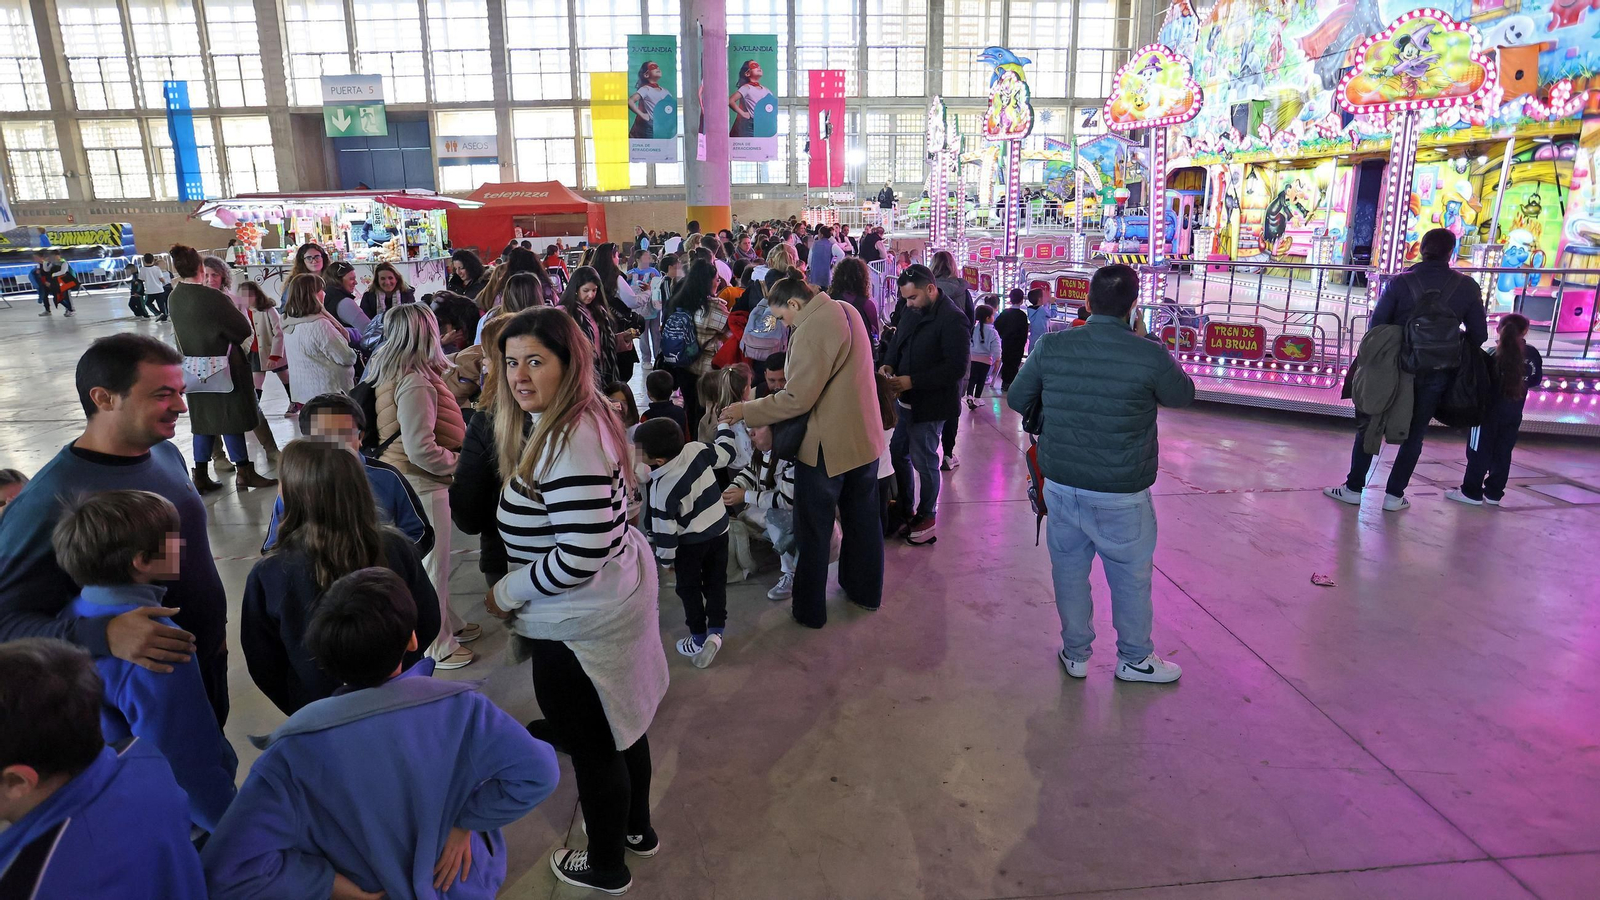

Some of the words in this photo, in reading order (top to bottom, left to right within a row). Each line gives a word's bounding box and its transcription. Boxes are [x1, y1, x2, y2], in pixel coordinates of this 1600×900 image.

[330, 86, 363, 95] PUERTA
[368, 85, 374, 94] 5
[462, 142, 489, 150] ASEOS
[483, 190, 550, 200] telepizza
[46, 229, 112, 246] ELIMINADOR
[1061, 279, 1077, 288] TREN
[1077, 281, 1086, 290] DE
[1060, 289, 1067, 297] LA
[1067, 290, 1087, 299] BRUJA
[1214, 326, 1239, 337] TREN
[1241, 327, 1255, 338] DE
[1211, 338, 1223, 348] LA
[1225, 339, 1258, 351] BRUJA
